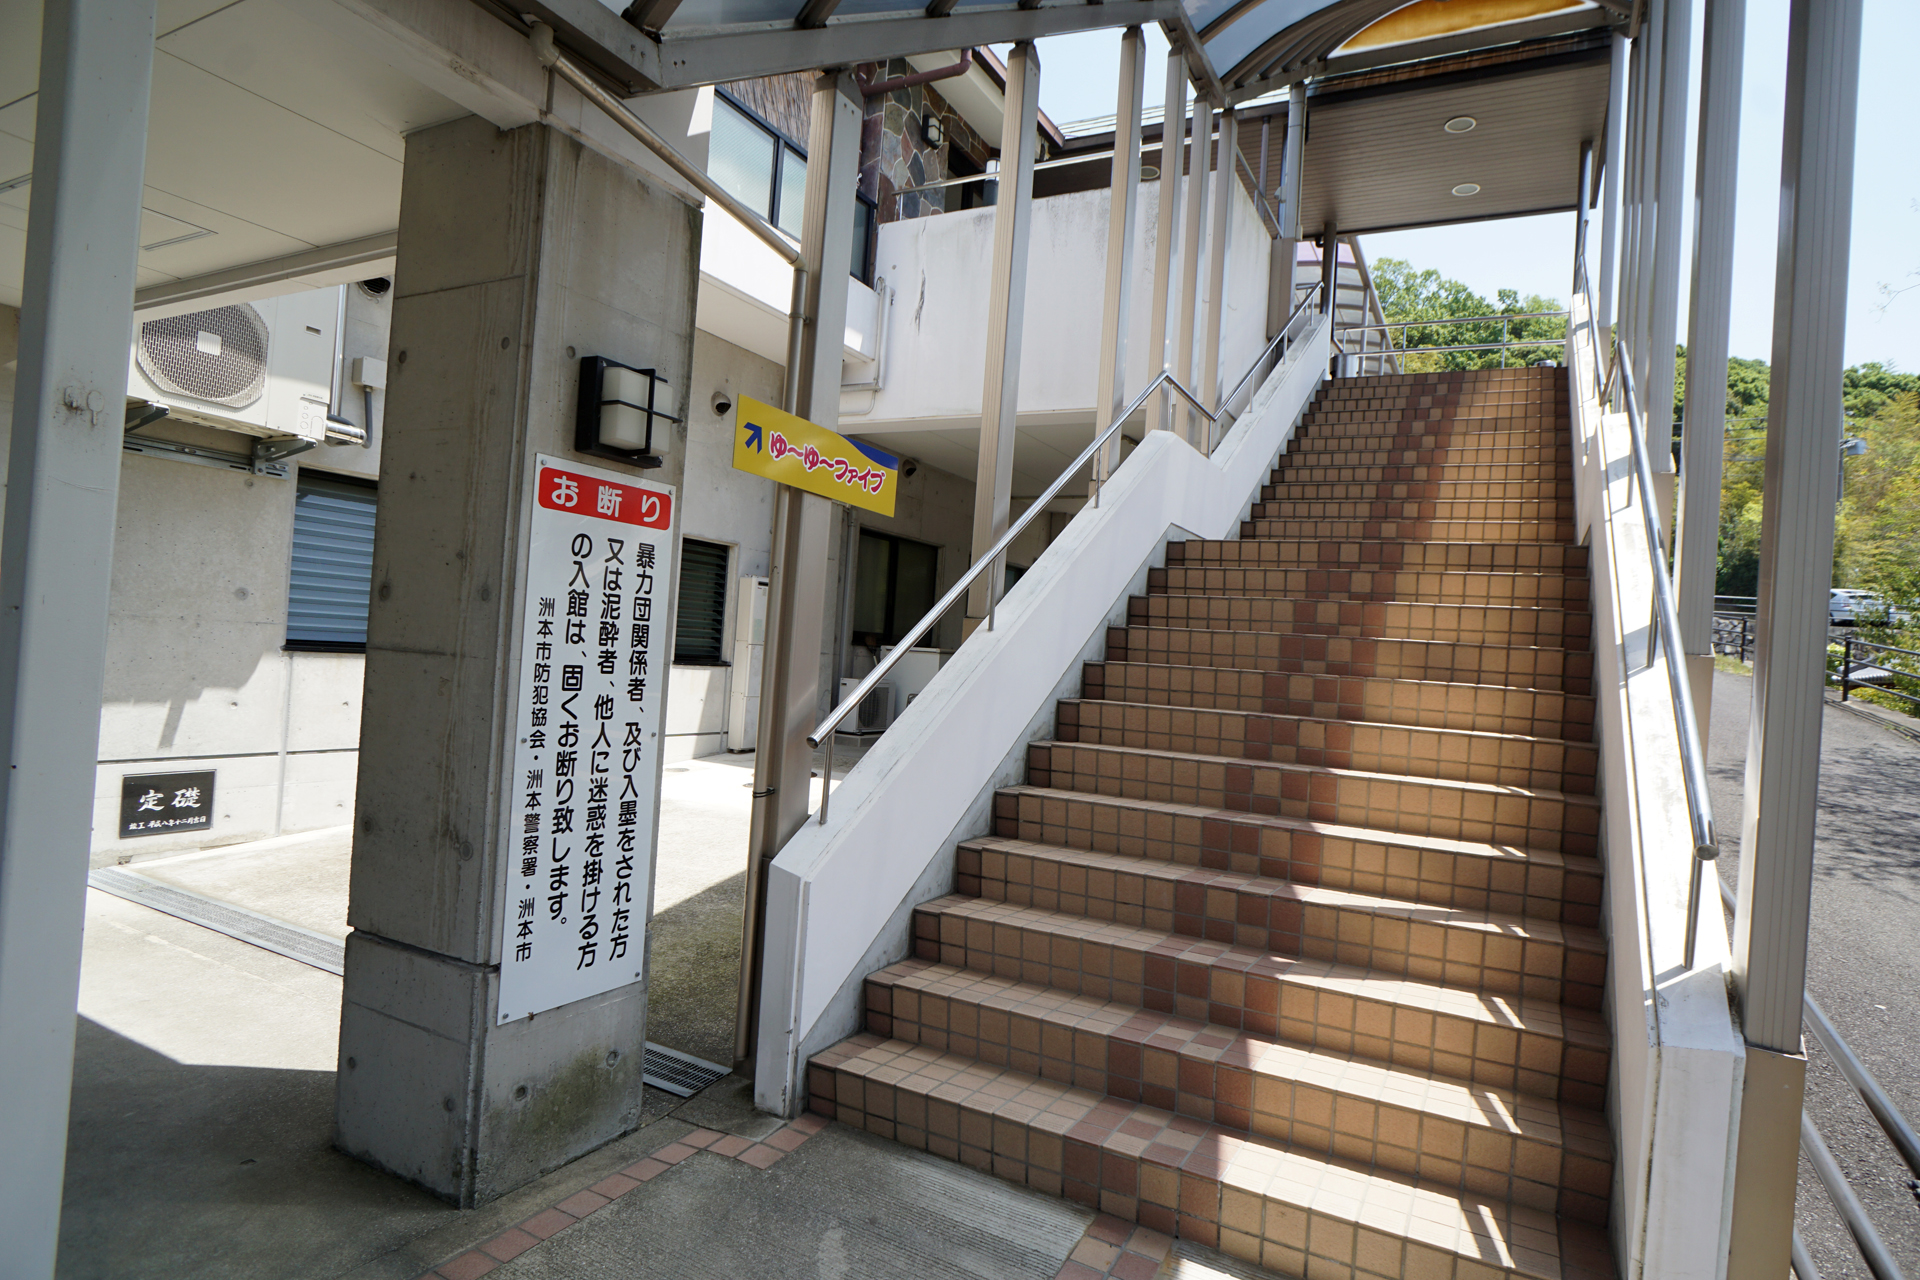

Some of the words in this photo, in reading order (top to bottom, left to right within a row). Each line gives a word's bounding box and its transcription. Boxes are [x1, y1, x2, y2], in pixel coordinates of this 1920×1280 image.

[551, 475, 661, 523] お断り
[138, 788, 201, 811] 定礎
[515, 596, 555, 963] 洲本市防犯協会・洲本警察署・洲本市
[548, 533, 593, 925] の入館は、固くお断り致します。
[577, 537, 625, 971] 又は泥酔者、他人に迷惑を掛ける方
[609, 542, 656, 962] 暴力団関係者、及び入墨をされた方
